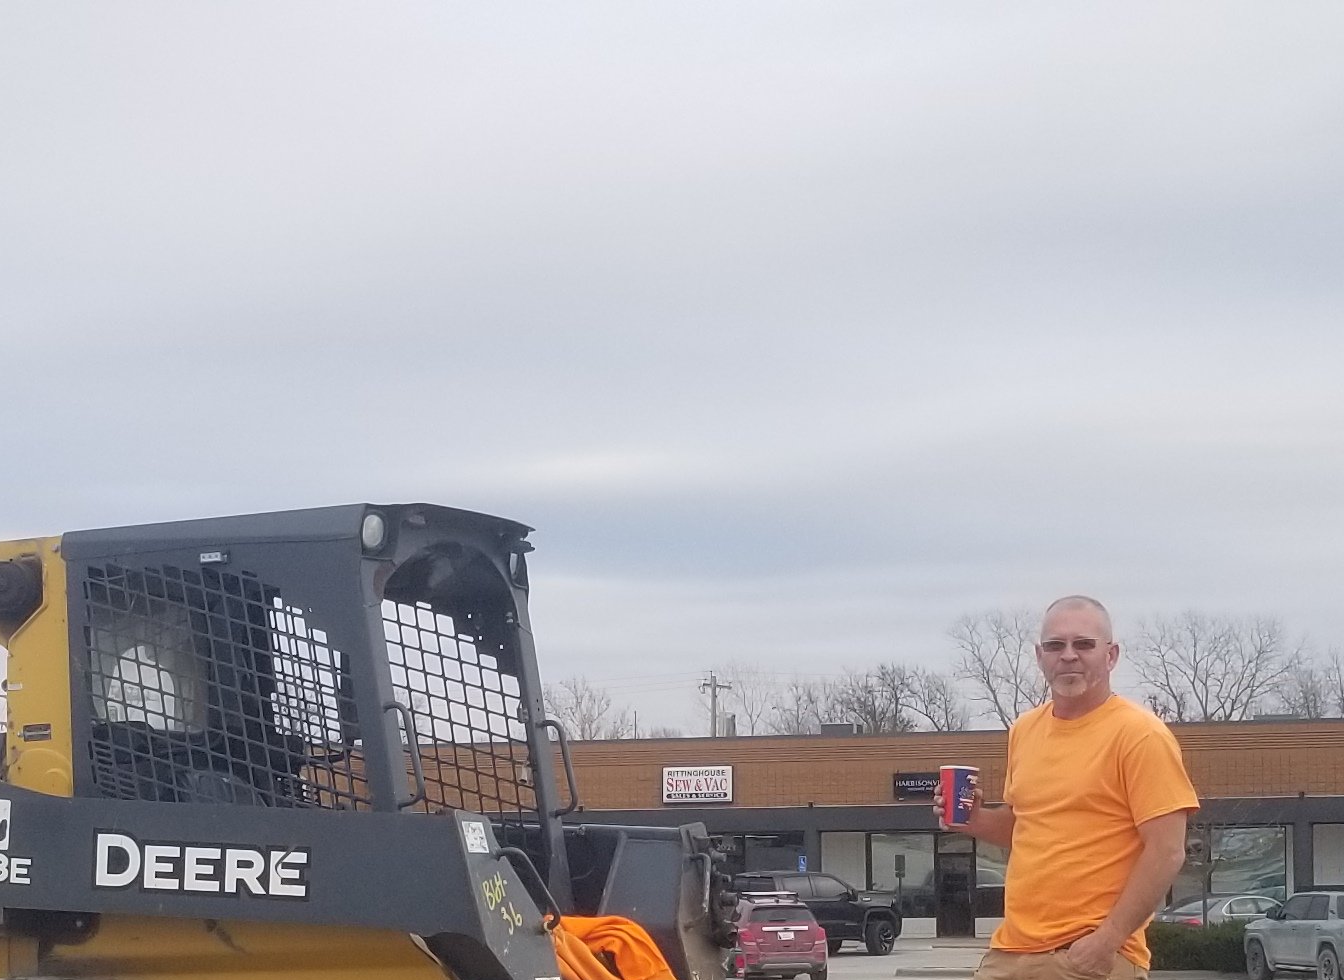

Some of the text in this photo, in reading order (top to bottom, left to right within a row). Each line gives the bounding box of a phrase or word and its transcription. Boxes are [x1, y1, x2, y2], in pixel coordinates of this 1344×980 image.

[666, 777, 728, 792] SEW & VAC
[95, 833, 308, 897] DEERE
